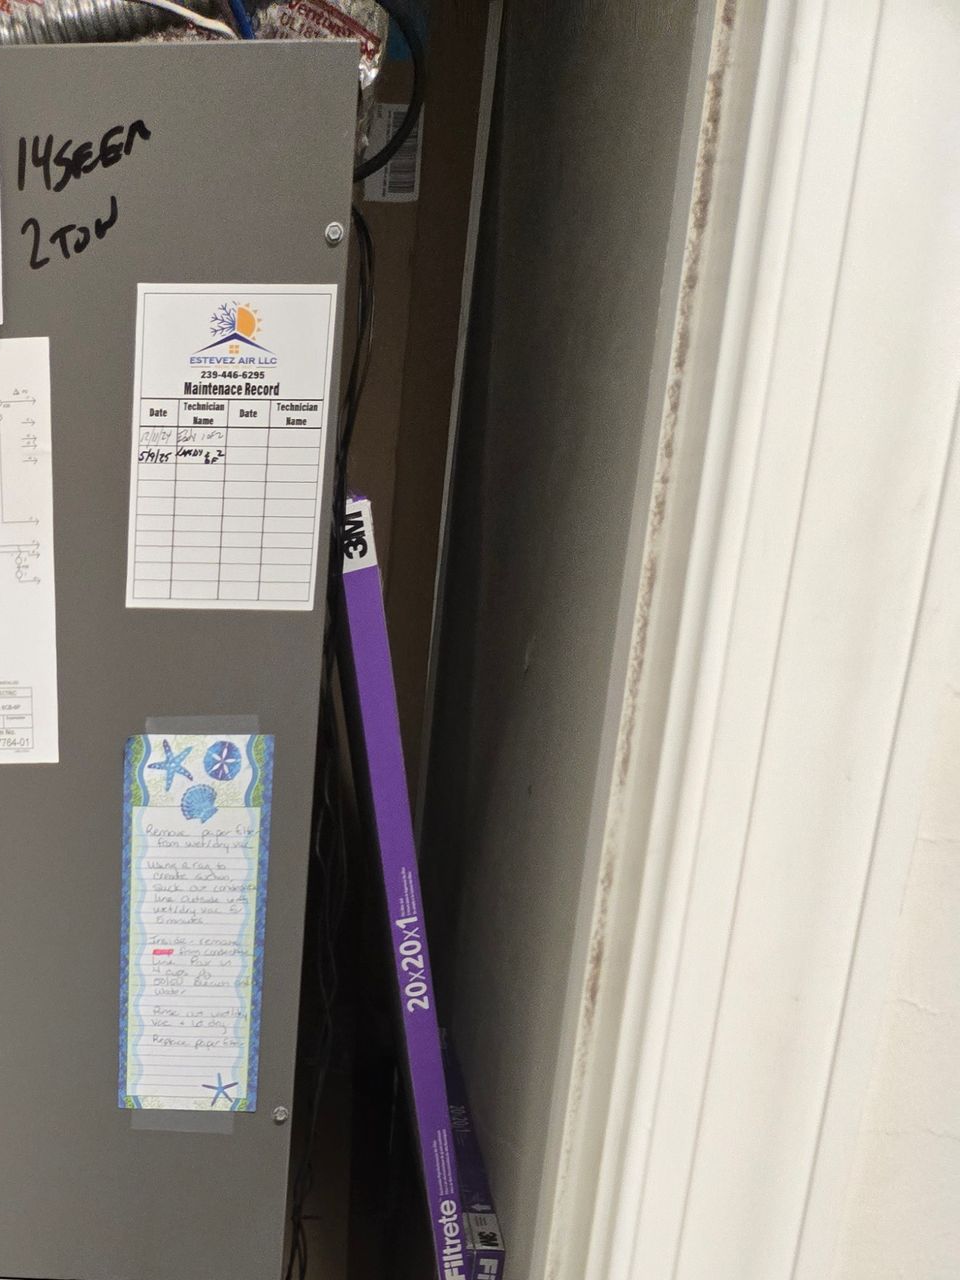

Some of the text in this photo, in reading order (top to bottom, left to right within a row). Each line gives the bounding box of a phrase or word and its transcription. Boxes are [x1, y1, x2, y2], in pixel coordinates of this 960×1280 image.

[21, 217, 50, 270] 2
[189, 356, 278, 366] ESTEVEZ AIR LLC
[200, 370, 265, 379] 239-446-6295
[183, 381, 280, 397] Maintenace Record
[183, 401, 225, 412] Technician
[276, 402, 318, 412] Technician
[149, 408, 168, 417] Date
[239, 408, 258, 418] Date
[193, 416, 214, 425] Name
[285, 417, 307, 426] Name
[343, 511, 368, 559] 3M
[395, 915, 430, 1013] 20x20x1
[477, 1231, 499, 1247] 3M
